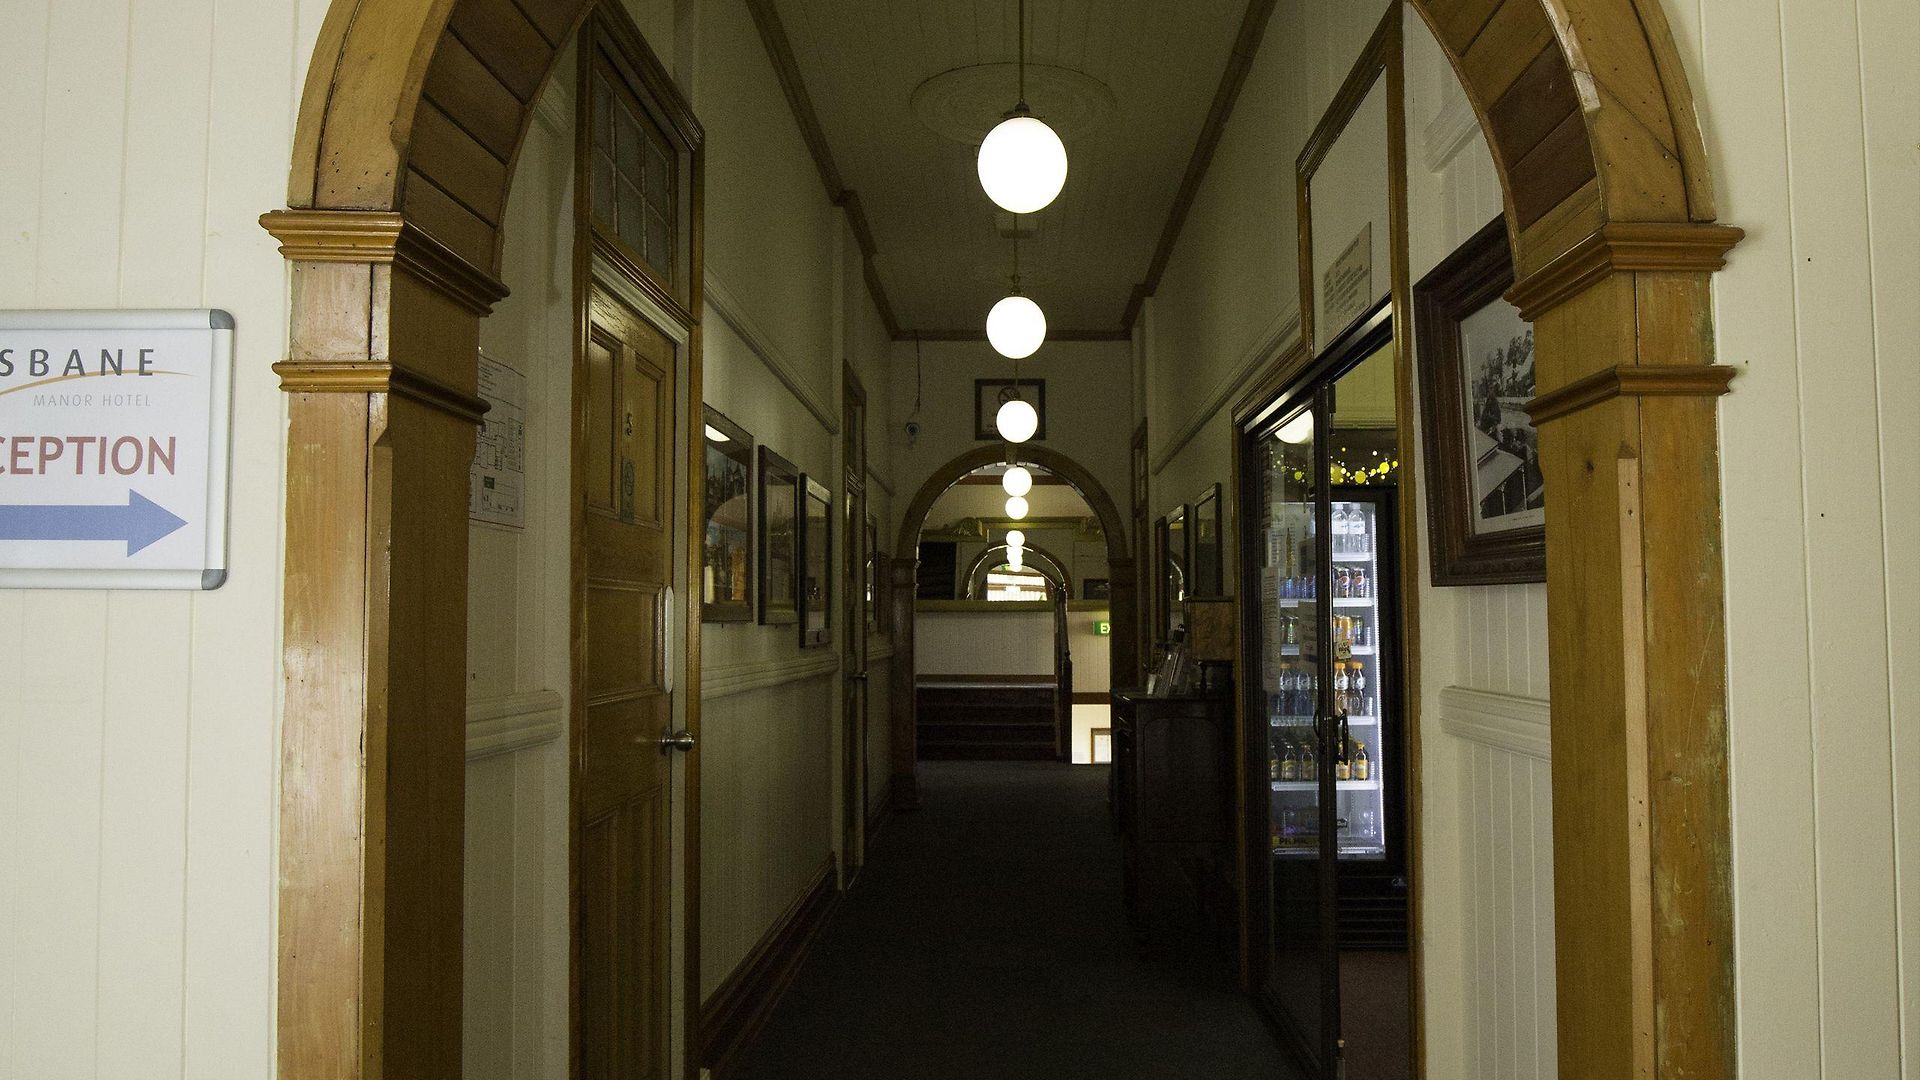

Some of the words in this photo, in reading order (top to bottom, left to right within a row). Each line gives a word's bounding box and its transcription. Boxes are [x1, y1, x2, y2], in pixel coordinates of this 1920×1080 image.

[0, 348, 154, 377] SBANE
[33, 394, 93, 407] MANOR
[102, 394, 151, 407] HOTEL
[0, 436, 176, 476] EPTION
